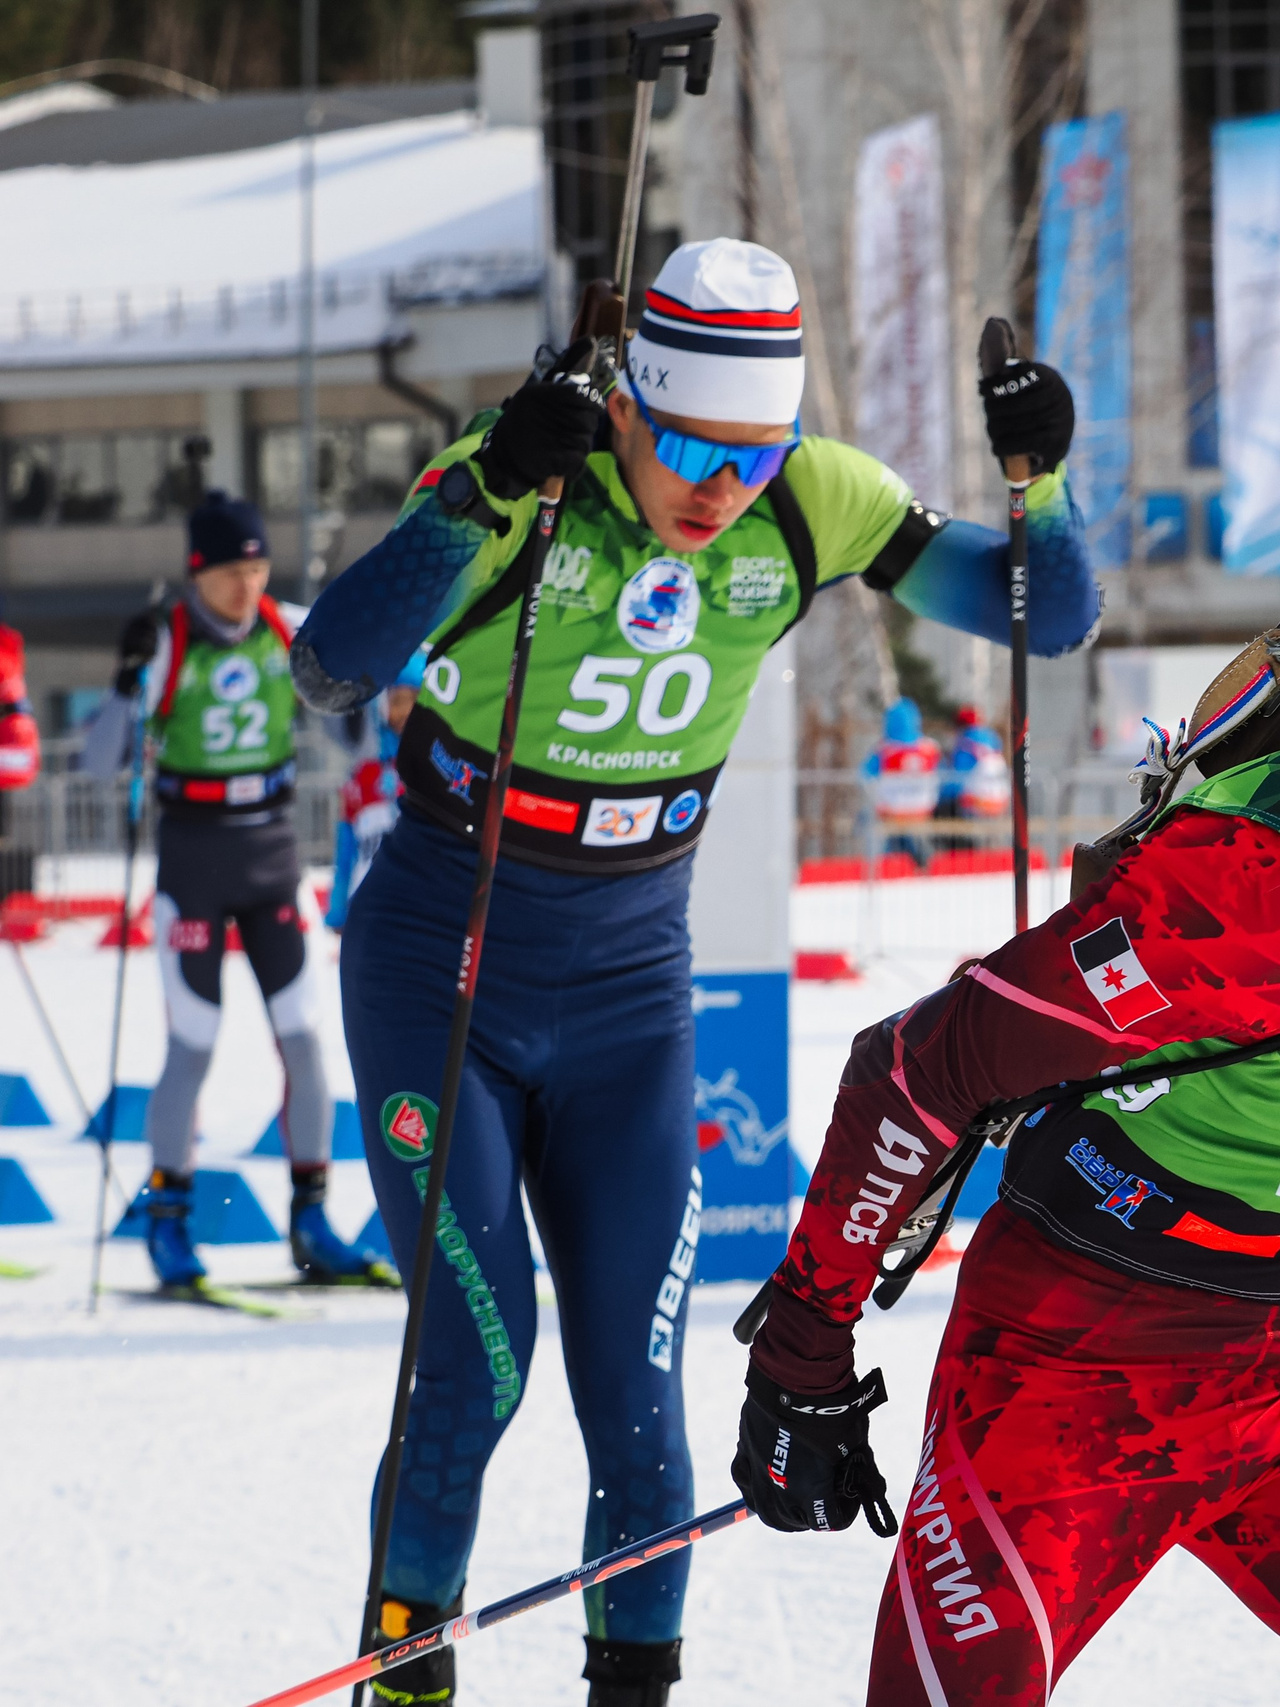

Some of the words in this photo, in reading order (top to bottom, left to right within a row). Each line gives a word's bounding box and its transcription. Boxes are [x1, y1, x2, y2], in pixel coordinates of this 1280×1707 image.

[992, 369, 1040, 397] MOAX
[522, 582, 543, 639] MOAX
[1010, 565, 1027, 622] MOAX
[555, 651, 713, 736] 50
[201, 699, 270, 754] 52
[546, 741, 684, 771] КРАСНОЯРСК
[456, 934, 475, 993] MOAX
[1068, 1143, 1121, 1188] СБР
[842, 1171, 905, 1246] ПСБ
[791, 1384, 877, 1416] PILOT
[385, 1631, 438, 1663] PILOT
